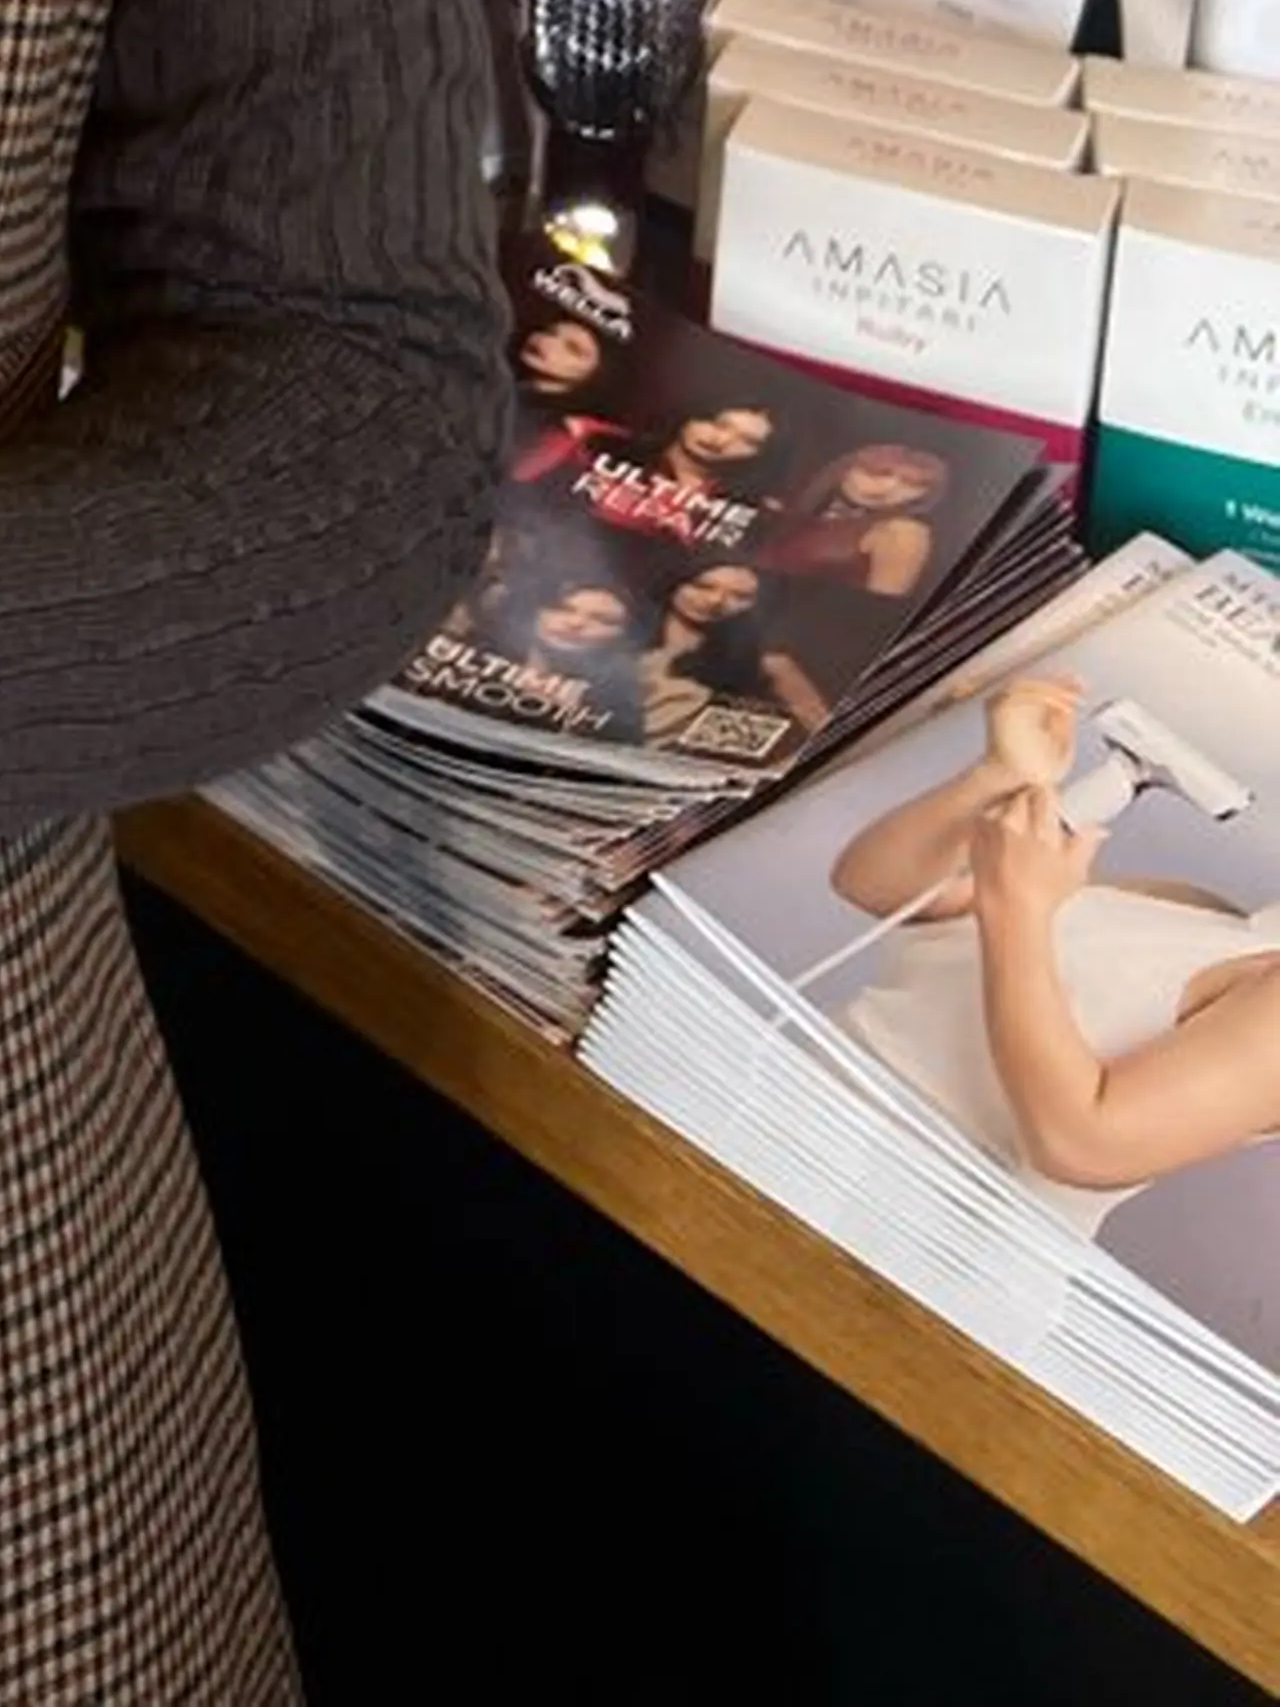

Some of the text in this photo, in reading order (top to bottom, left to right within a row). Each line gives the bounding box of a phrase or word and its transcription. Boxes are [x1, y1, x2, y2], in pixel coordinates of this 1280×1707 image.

[782, 229, 1012, 317] AMASIA
[570, 472, 746, 549] REPAIR
[593, 451, 760, 533] ULTIME
[403, 653, 615, 735] SMOOTH
[424, 632, 592, 709] ULTIME
